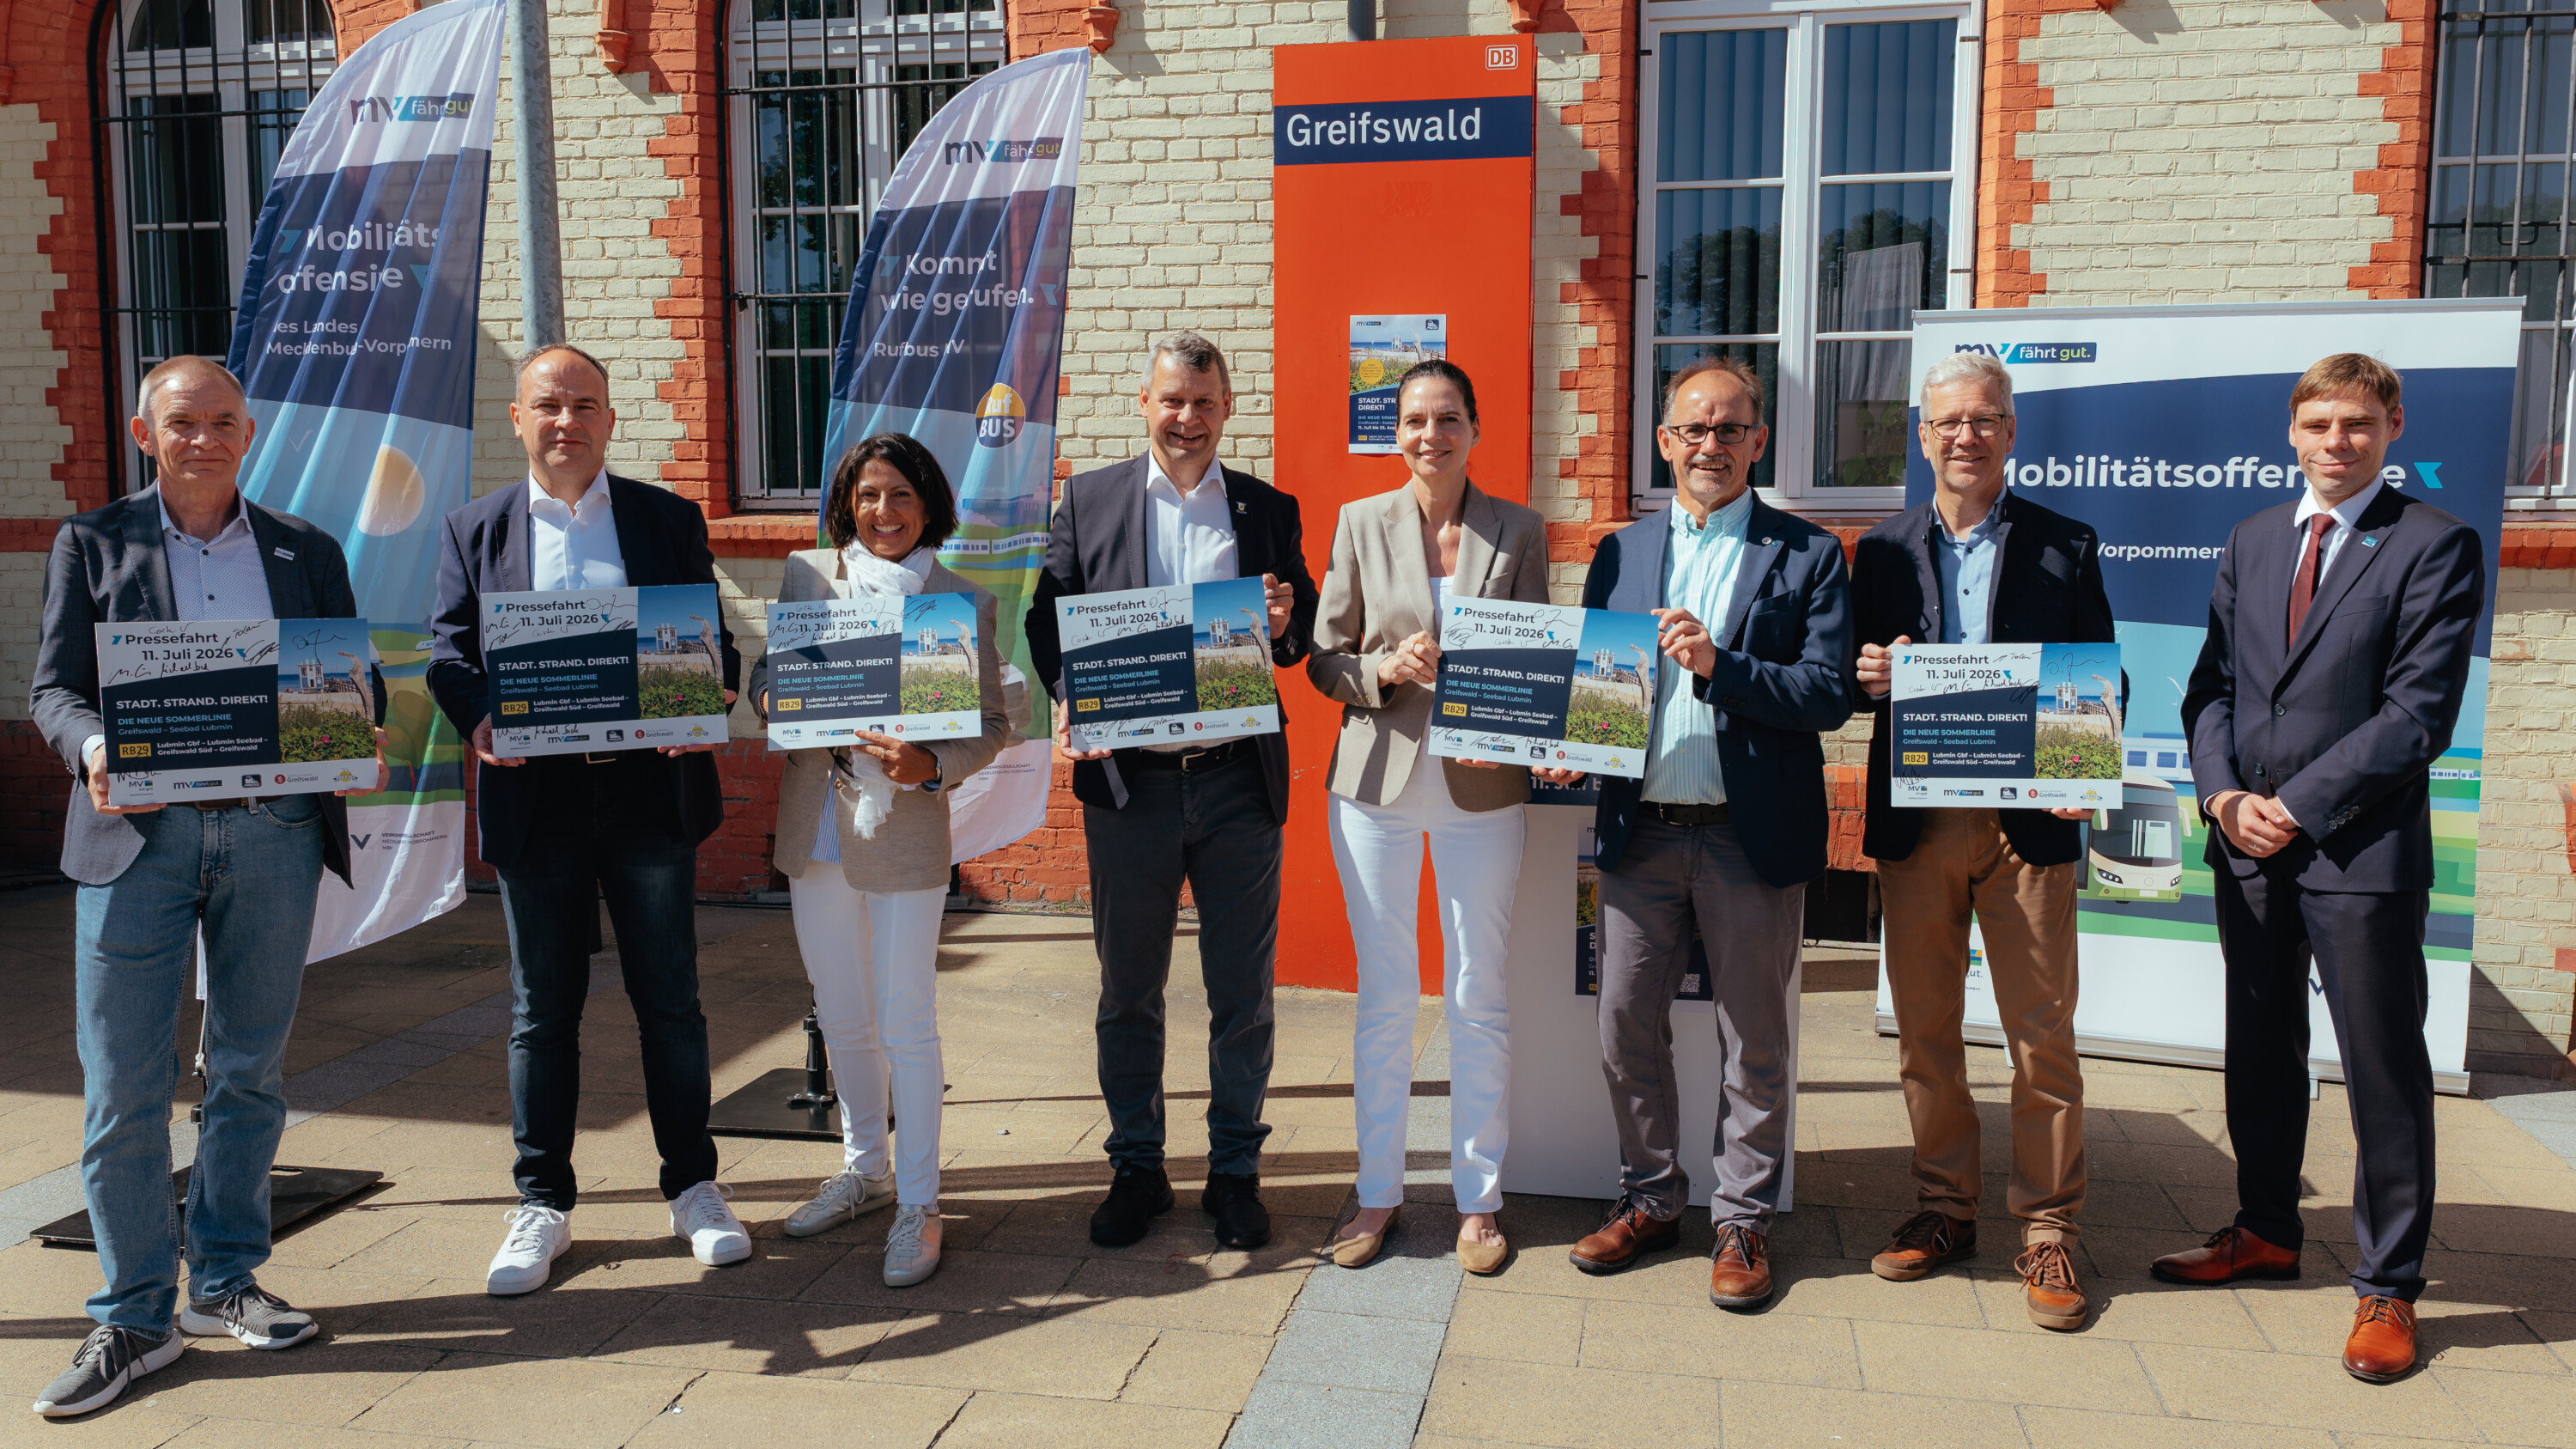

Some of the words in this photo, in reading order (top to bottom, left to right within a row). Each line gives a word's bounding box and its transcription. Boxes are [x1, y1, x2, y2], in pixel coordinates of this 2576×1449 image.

[1490, 49, 1514, 66] DB
[1287, 107, 1480, 147] Greifswald
[880, 285, 926, 312] wie
[303, 319, 358, 334] Landes
[873, 341, 939, 357] Rufbus
[2020, 346, 2057, 359] fährt
[2060, 346, 2091, 361] gut.
[985, 393, 1012, 414] Ruf
[979, 418, 1016, 438] BUS
[506, 600, 585, 612] Pressefahrt
[1077, 600, 1146, 615] Pressefahrt
[520, 617, 534, 626] 11.
[538, 615, 562, 625] Juli
[566, 614, 598, 624] 2026
[787, 608, 856, 620] Pressefahrt
[1090, 618, 1102, 627] 11.
[1105, 615, 1126, 626] Juli
[1129, 612, 1158, 624] 2026
[1464, 607, 1534, 624] Pressefahrt
[799, 624, 811, 632] 11.
[815, 622, 835, 631] Juli
[839, 621, 867, 630] 2026
[1473, 624, 1486, 633] 11.
[1490, 624, 1511, 636] Juli
[1515, 628, 1544, 639] 2026
[125, 633, 218, 645] Pressefahrt
[142, 650, 158, 661] 11.
[162, 648, 191, 660] Juli
[196, 648, 234, 659] 2026
[1072, 660, 1105, 671] STADT.
[1107, 655, 1148, 667] STRAND.
[1150, 651, 1187, 662] DIREKT!
[1914, 655, 1989, 664] Pressefahrt
[498, 661, 537, 671] STADT.
[538, 659, 586, 668] STRAND.
[587, 656, 629, 666] DIREKT!
[777, 663, 811, 672] STADT.
[813, 661, 854, 669] STRAND.
[856, 658, 893, 667] DIREKT!
[540, 673, 598, 683] SOMMERLINIE
[813, 673, 864, 682] SOMMERLINIE
[1109, 669, 1159, 680] SOMMERLINIE
[1447, 664, 1481, 675] STADT.
[1483, 668, 1525, 679] STRAND.
[1527, 673, 1564, 684] DIREKT!
[1926, 670, 1939, 679] 11.
[1943, 669, 1965, 679] Juli
[1970, 670, 2000, 679] 2026
[1445, 689, 1478, 697] Greifswald
[1483, 692, 1506, 701] Seebad
[1507, 695, 1532, 703] Lubmin
[1481, 684, 1533, 695] SOMMERLINIE
[116, 699, 161, 709] STADT.
[163, 697, 218, 707] STRAND.
[221, 695, 268, 704] DIREKT!
[504, 703, 526, 712] RB29
[1078, 701, 1098, 709] RB29
[1444, 704, 1465, 714] RB29
[137, 716, 163, 725] NEUE
[165, 713, 232, 723] SOMMERLINIE
[118, 727, 161, 735] Greifswald
[122, 746, 149, 755] RB29
